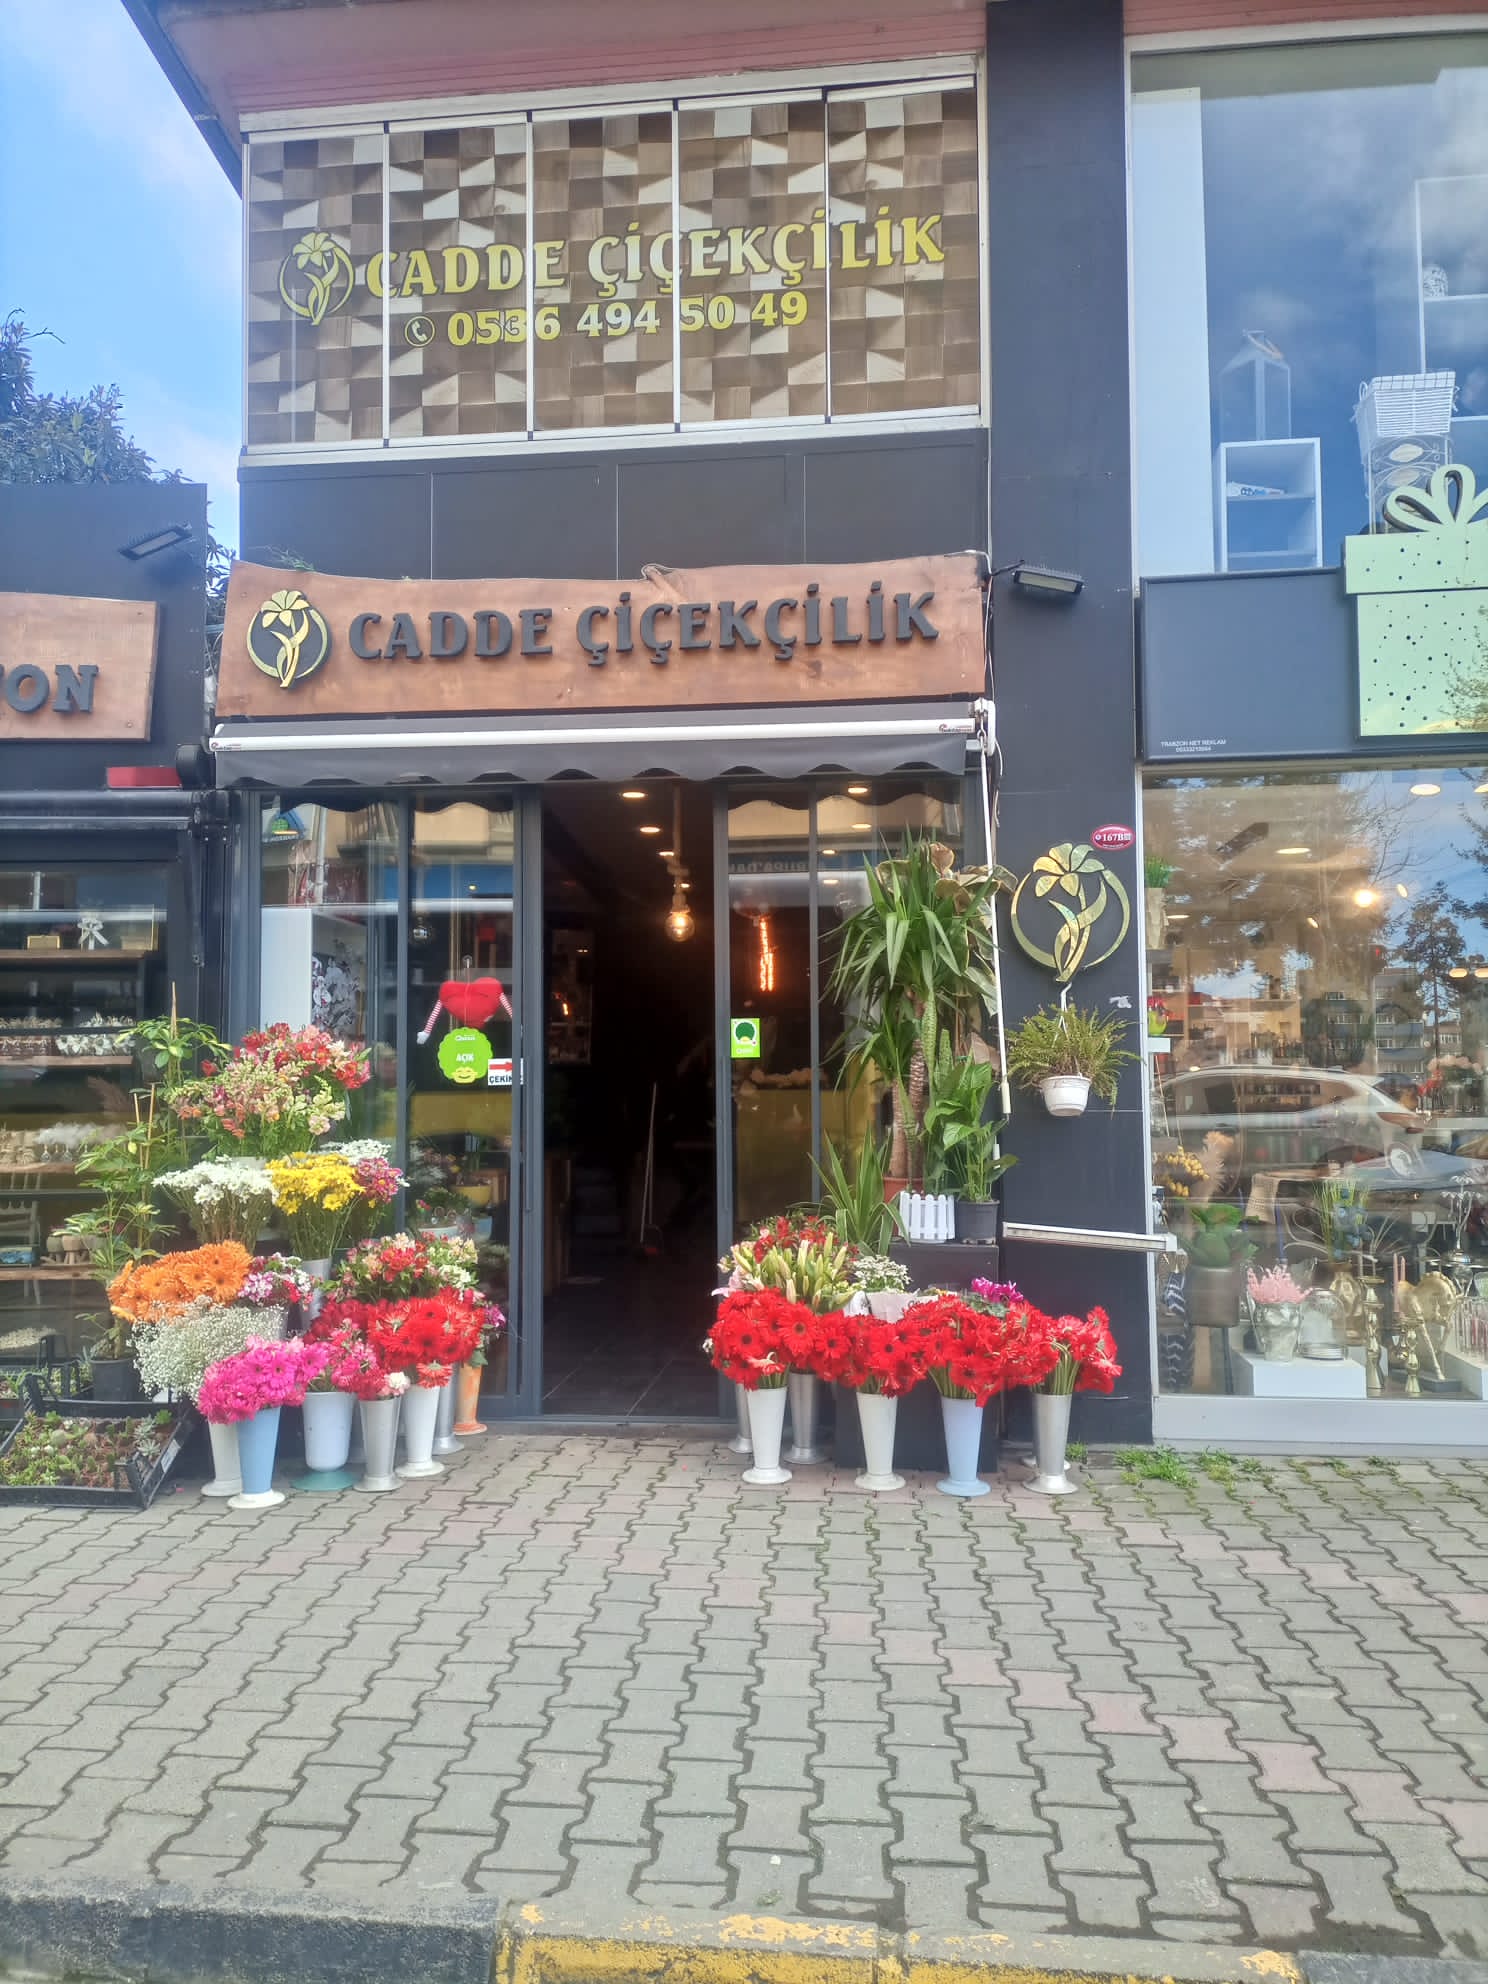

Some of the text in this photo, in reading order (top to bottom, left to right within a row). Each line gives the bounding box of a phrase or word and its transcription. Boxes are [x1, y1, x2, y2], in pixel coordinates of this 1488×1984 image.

[366, 206, 945, 298] CADDE ÇİÇEKÇİLİK
[447, 291, 808, 346] 0536 494 50 49
[349, 581, 940, 666] CADDE ÇİÇEKÇİLİK
[0, 663, 99, 713] ON
